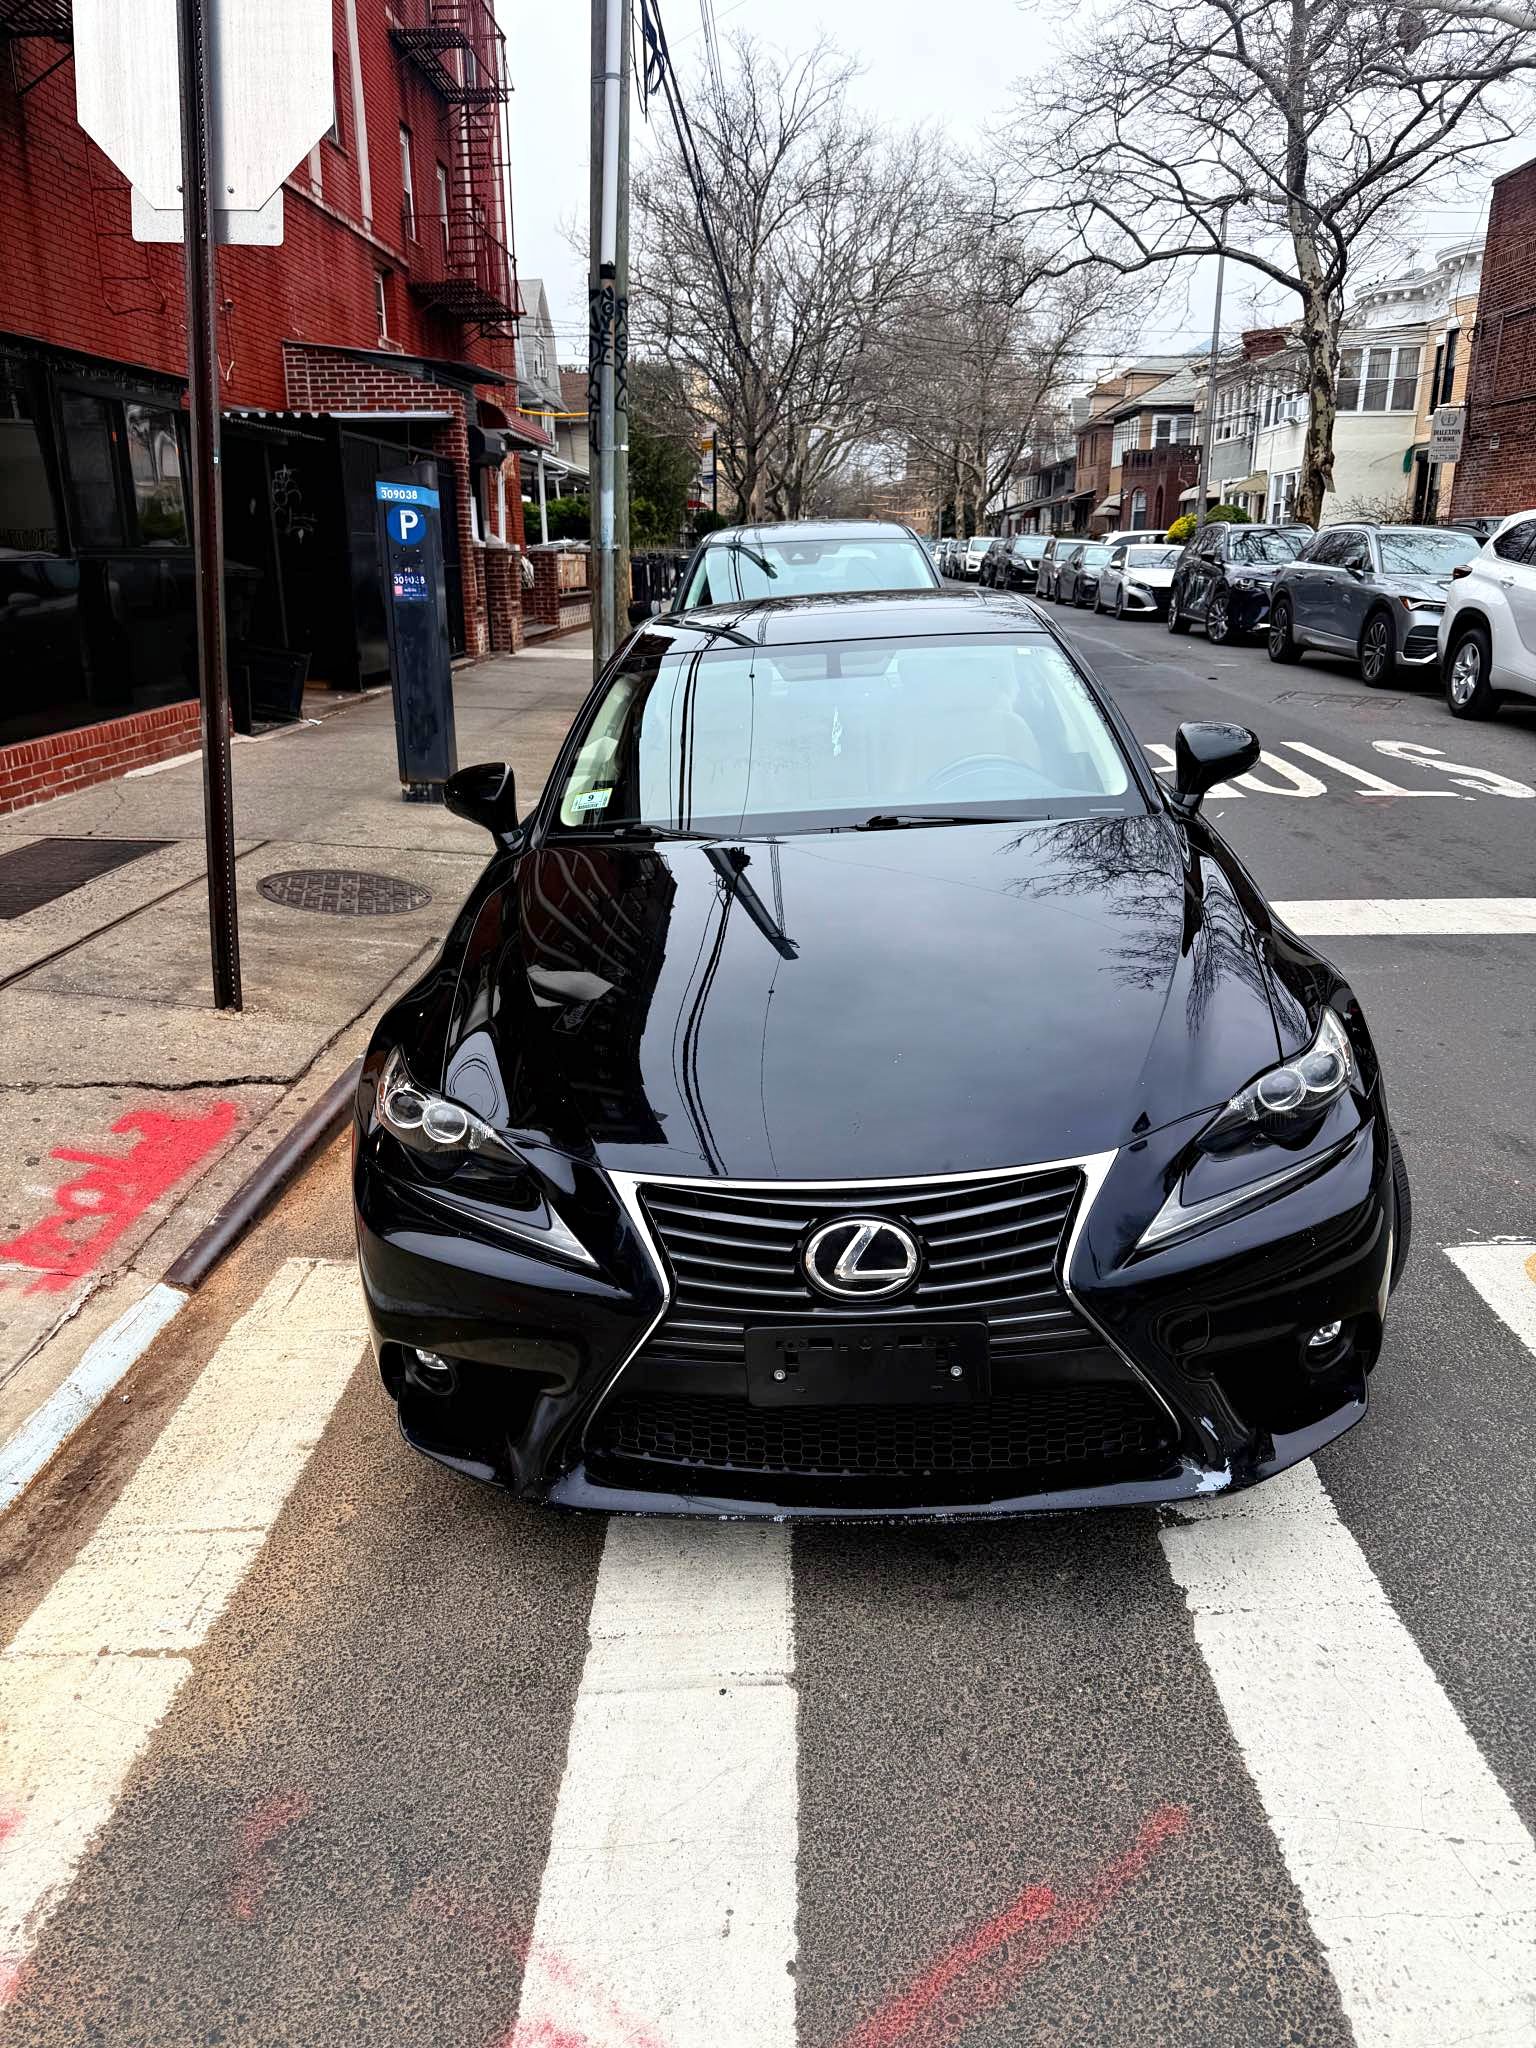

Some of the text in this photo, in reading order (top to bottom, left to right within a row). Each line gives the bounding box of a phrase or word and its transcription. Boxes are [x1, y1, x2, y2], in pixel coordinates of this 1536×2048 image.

[381, 489, 417, 499] 309038
[400, 510, 418, 539] P
[394, 576, 425, 584] 309038
